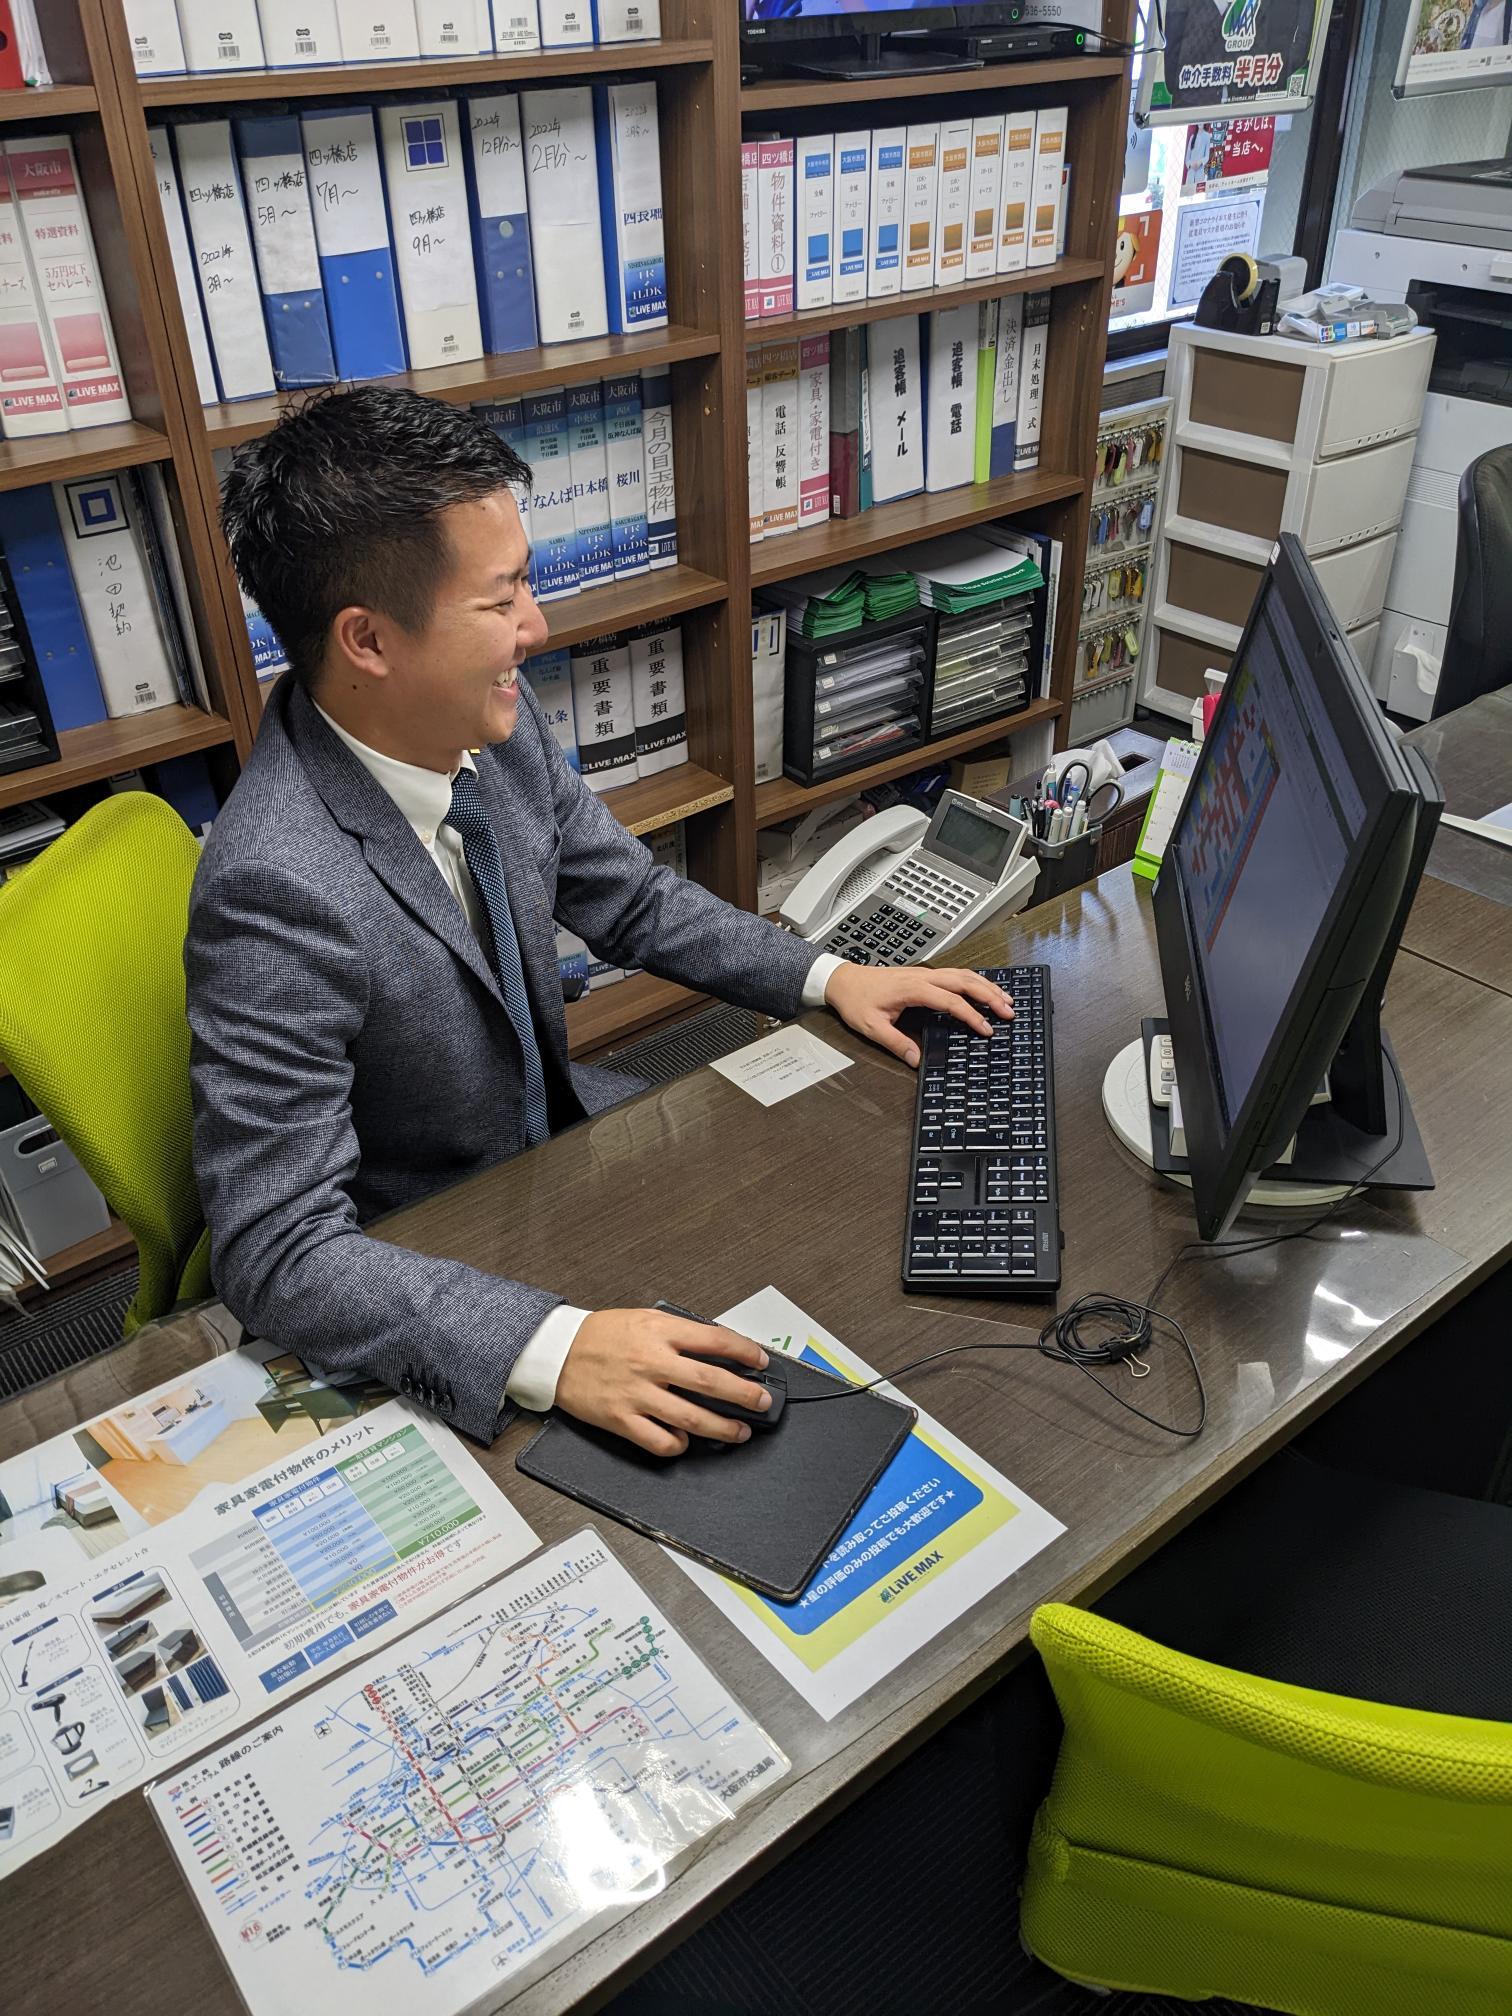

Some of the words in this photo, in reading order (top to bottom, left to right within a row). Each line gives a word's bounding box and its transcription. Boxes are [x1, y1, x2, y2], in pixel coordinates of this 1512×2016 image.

[1227, 40, 1252, 49] GROUP
[1182, 64, 1232, 85] 仲介手数料
[1235, 55, 1282, 86] 半月分
[1232, 141, 1263, 157] 当店へ。
[22, 159, 62, 177] 大阪市
[34, 223, 80, 240] 特選資料
[651, 300, 667, 313] MAX
[893, 347, 906, 397] 追客帳
[951, 341, 964, 389] 追客帳
[98, 382, 120, 395] MAX
[608, 383, 638, 399] 大阪市
[1026, 342, 1041, 429] 月末処理一式
[36, 392, 60, 406] MAX
[531, 400, 562, 417] 大阪市
[570, 391, 600, 407] 大阪市
[775, 404, 787, 436] 電話
[950, 402, 963, 435] 電話
[896, 410, 908, 457] メール
[648, 411, 675, 516] 今月の目玉物件
[775, 445, 787, 489] 反響帳
[573, 477, 609, 499] 日本橋
[616, 470, 641, 488] 桜川
[534, 487, 573, 509] なんば
[564, 571, 580, 585] MAX
[648, 638, 668, 718] 重要書類
[591, 657, 615, 738] 重要書類
[666, 730, 687, 744] MAX
[614, 750, 636, 765] MAX
[213, 1422, 375, 1517] 家具家電付物件のメリット
[417, 1518, 460, 1546] ¥710,000
[914, 1550, 944, 1576] MAX
[218, 1724, 284, 1769] 路線のご案内
